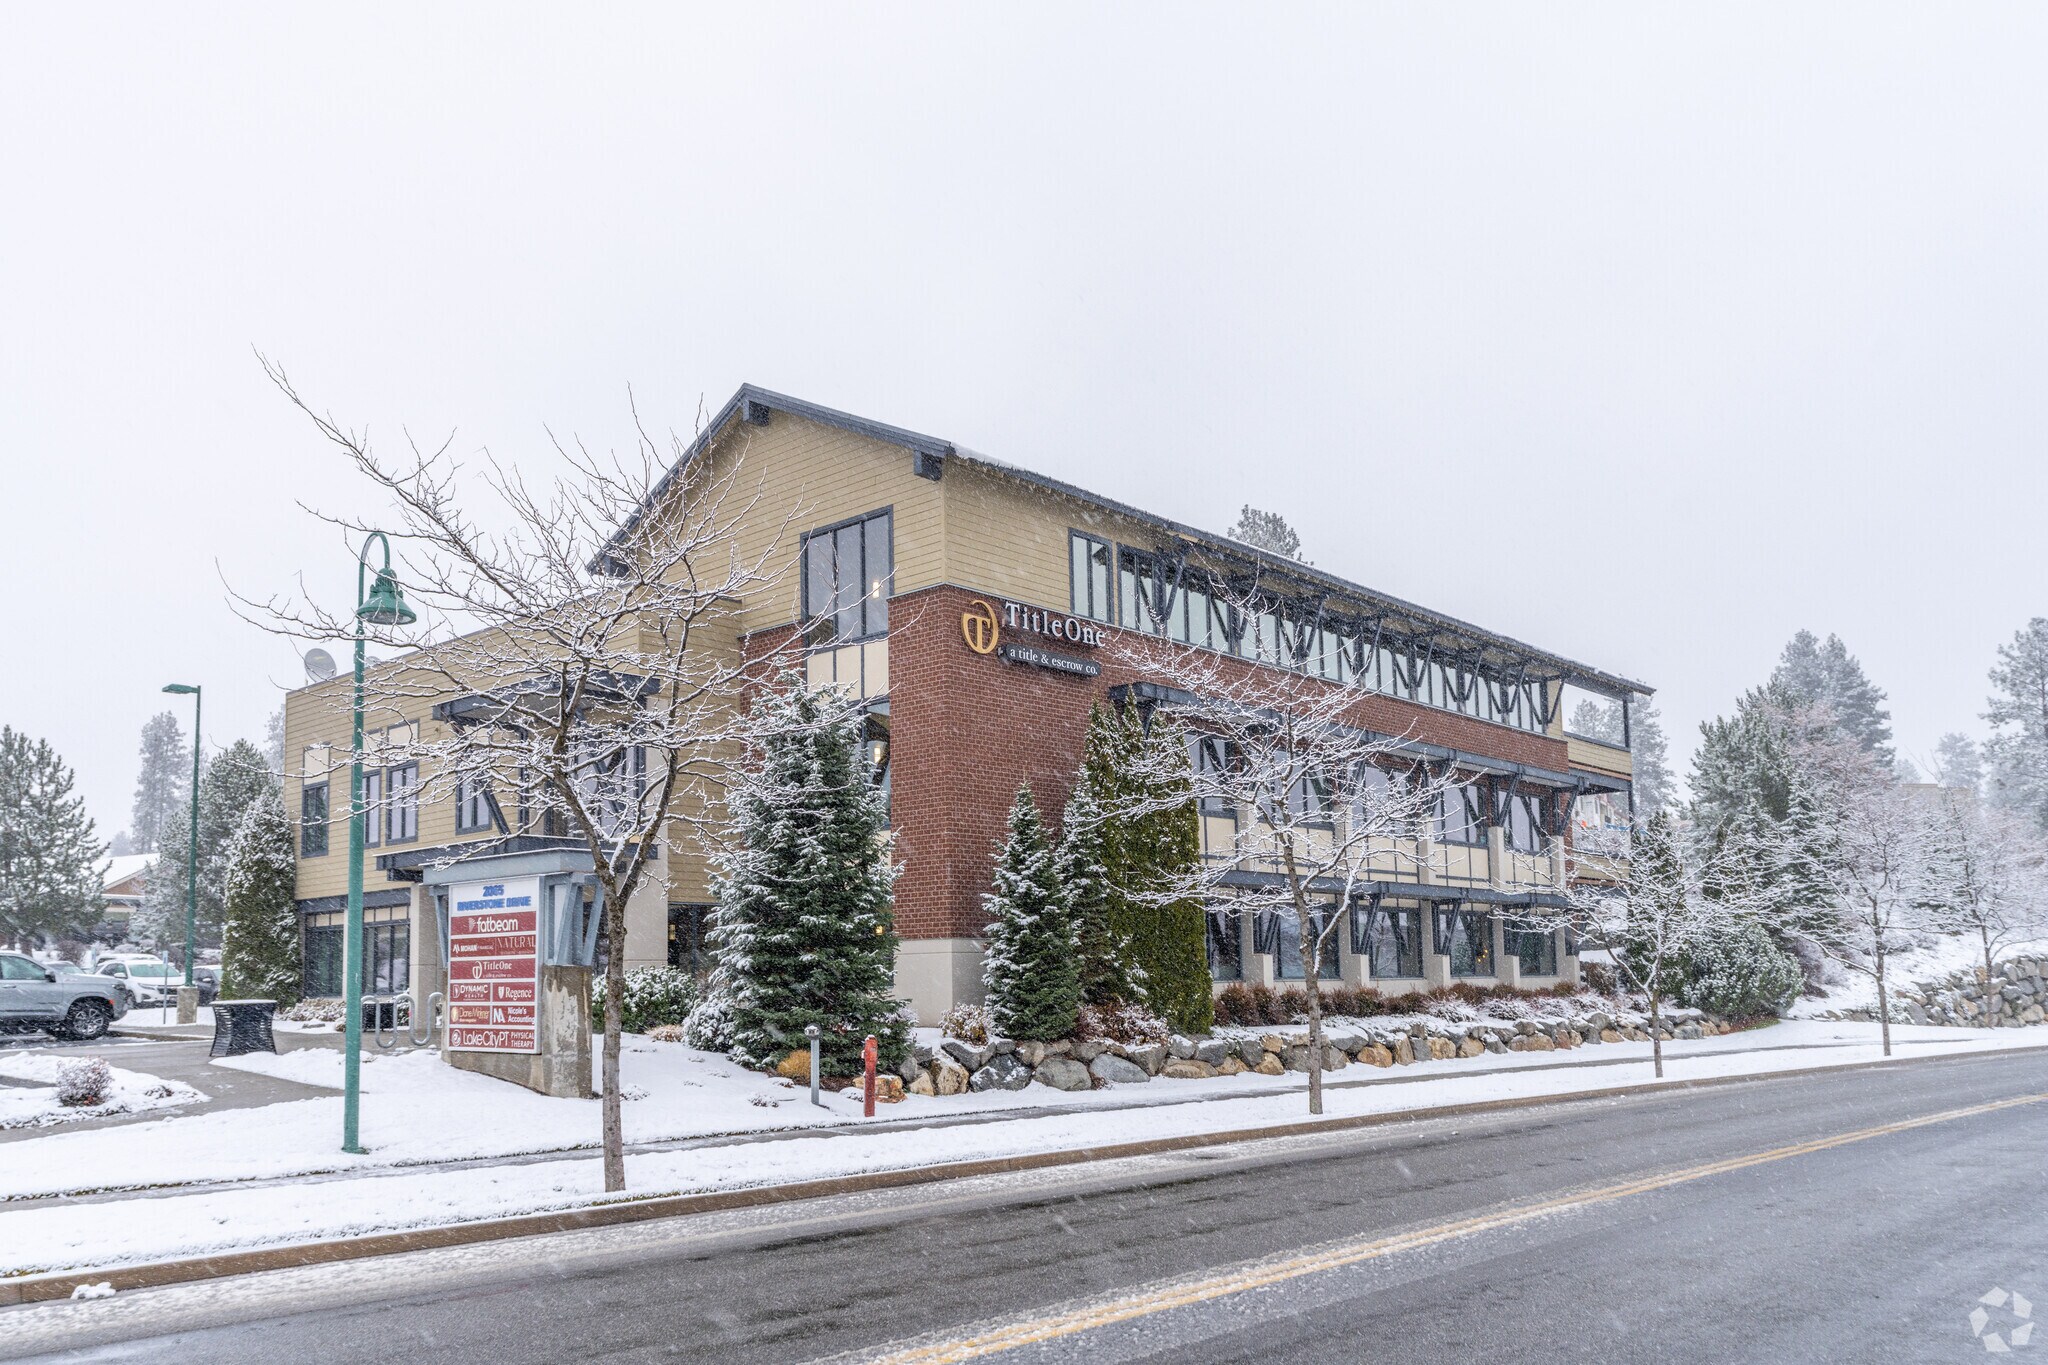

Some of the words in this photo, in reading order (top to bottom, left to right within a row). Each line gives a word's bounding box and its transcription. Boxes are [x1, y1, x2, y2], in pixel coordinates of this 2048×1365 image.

[1005, 601, 1107, 648] TitleOne
[1009, 647, 1017, 658] a
[1018, 647, 1038, 663] title
[1040, 653, 1049, 665] &
[1051, 657, 1084, 672] escrow
[1085, 664, 1098, 675] co.
[457, 898, 505, 911] RIVERSTONE
[506, 896, 531, 908] DRIVE
[476, 916, 519, 933] fatbeam
[497, 935, 536, 949] NATURAL
[483, 960, 513, 971] TitleOne
[460, 984, 489, 994] DYNAMIC
[505, 986, 532, 1001] Regence
[507, 1007, 527, 1015] Nicole's
[508, 1015, 535, 1025] Accounting
[463, 1030, 510, 1048] LakeCityPT
[511, 1040, 534, 1048] THERAPY
